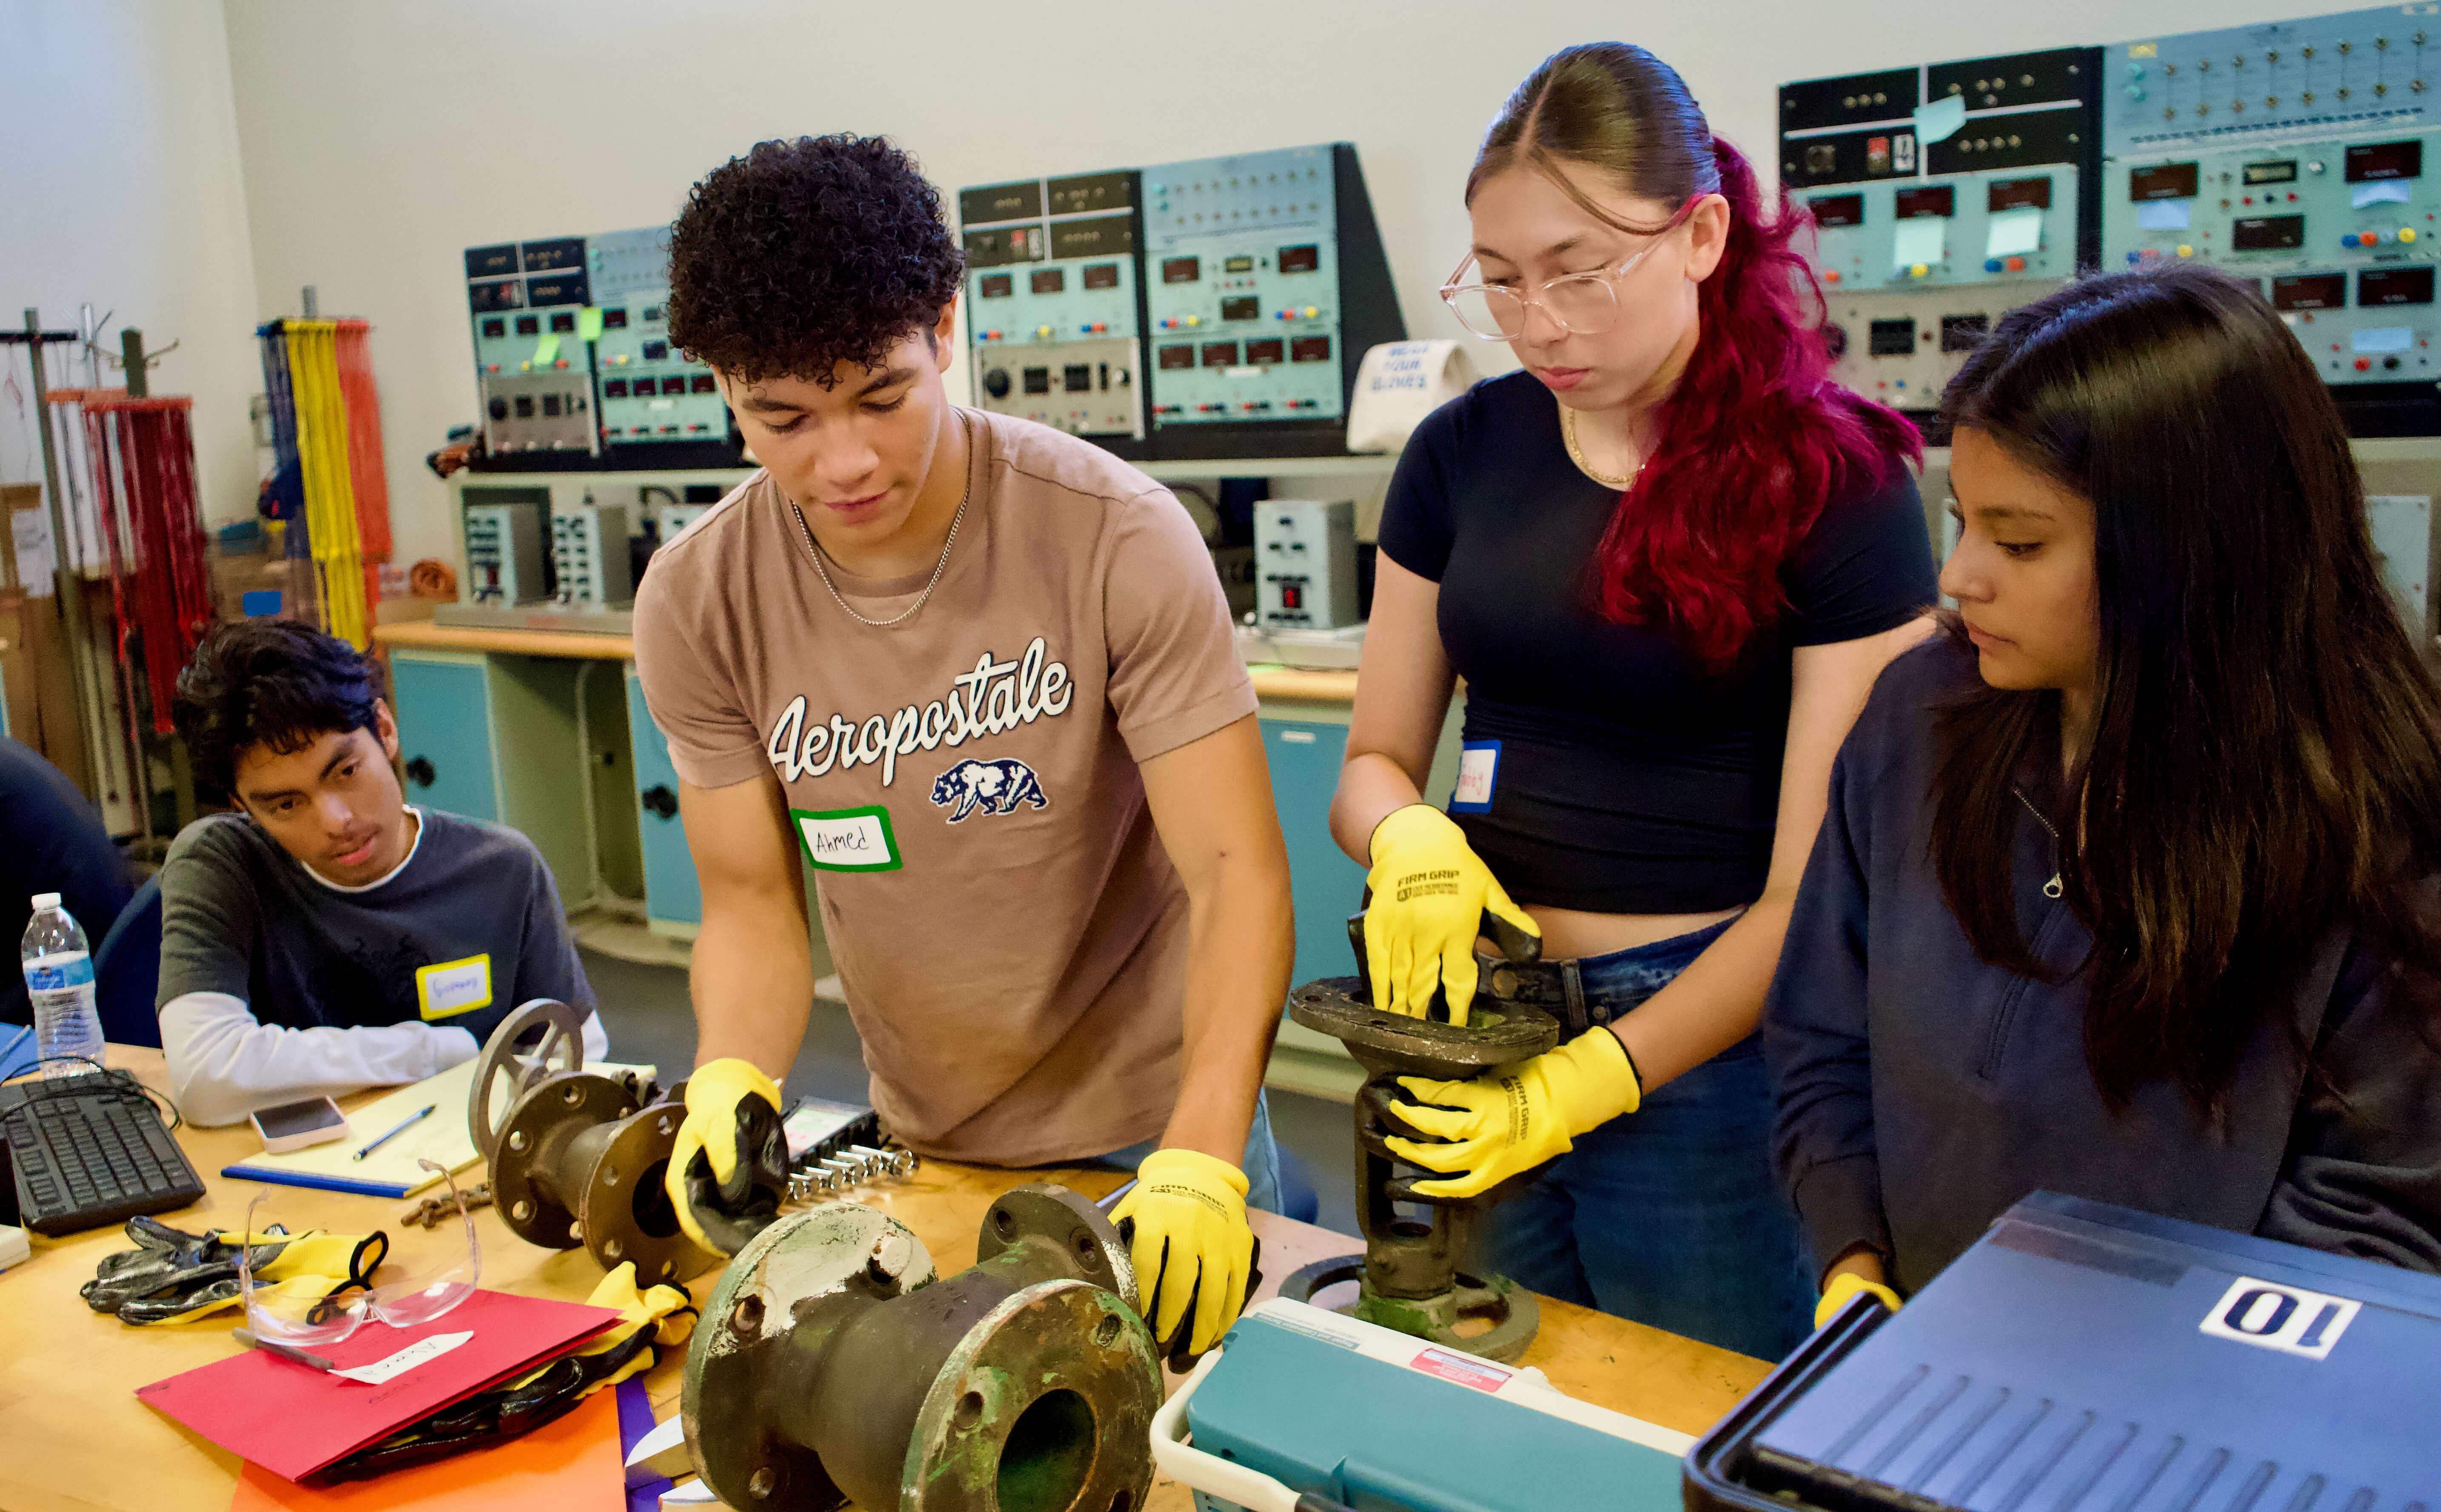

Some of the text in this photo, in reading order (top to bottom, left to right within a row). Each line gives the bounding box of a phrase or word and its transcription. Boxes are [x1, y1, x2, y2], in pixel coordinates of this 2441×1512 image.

[767, 636, 1073, 786] Aeropostale
[815, 825, 870, 853] Ahmed
[1398, 869, 1460, 887] FIRM GRIP
[1510, 1075, 1528, 1106] FIRM
[1520, 1107, 1529, 1140] GRIP
[2223, 1289, 2343, 1348] 10
